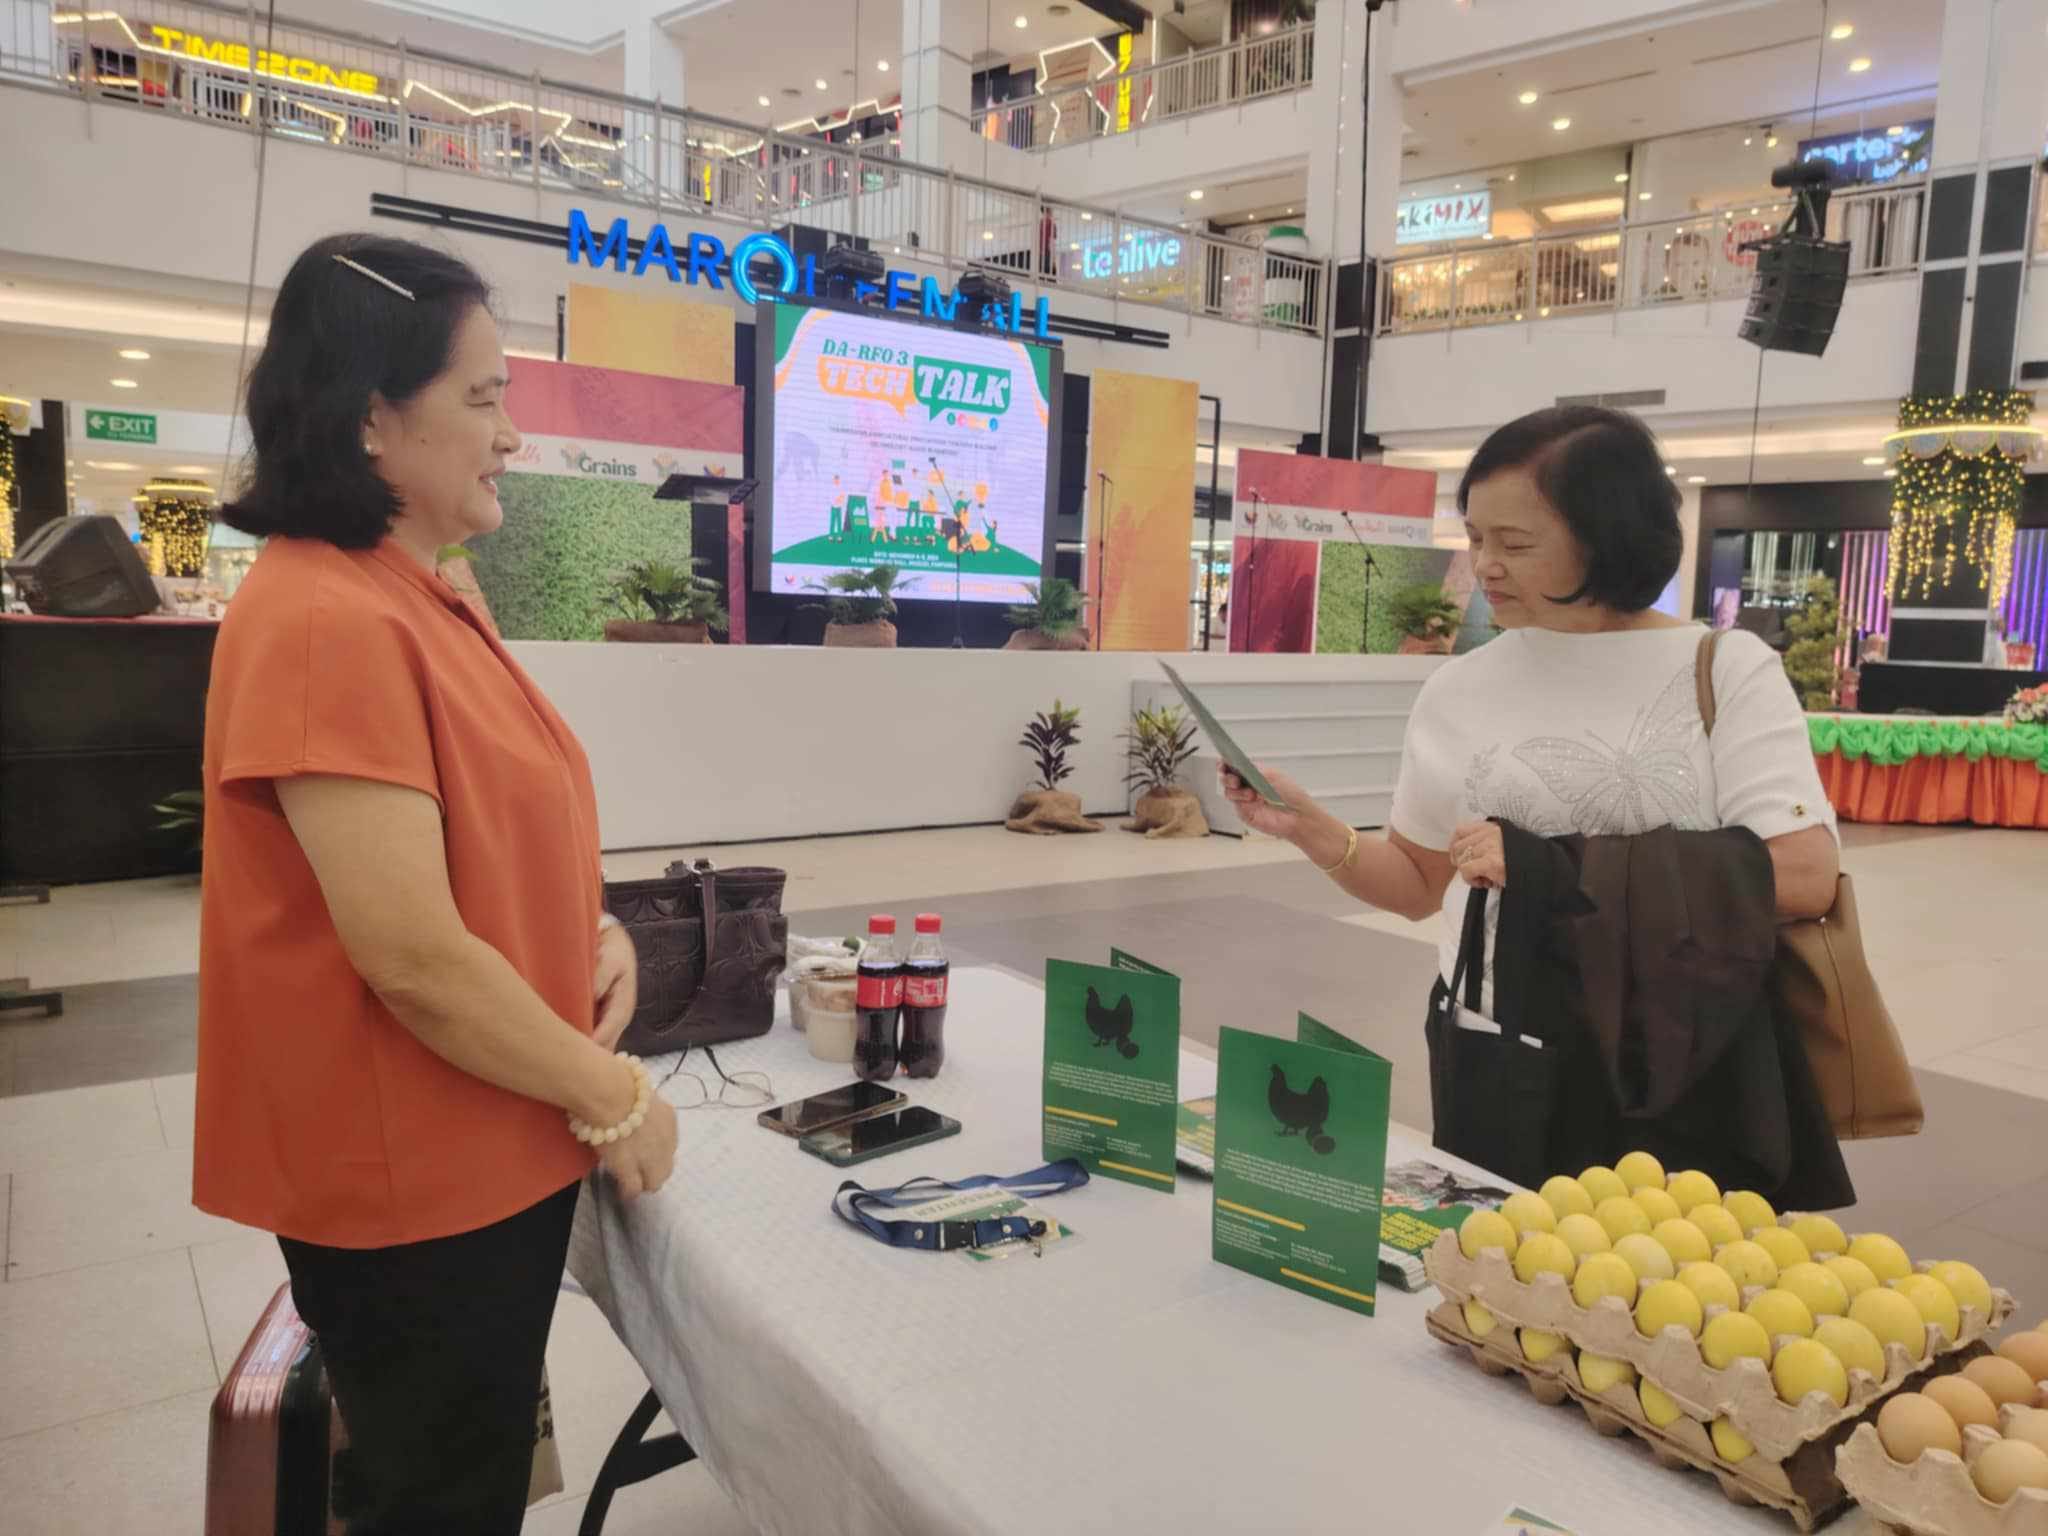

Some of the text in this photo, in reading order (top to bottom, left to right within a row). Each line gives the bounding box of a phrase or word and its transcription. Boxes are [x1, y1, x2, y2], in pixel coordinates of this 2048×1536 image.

[152, 25, 378, 96] TIMEZONE
[824, 362, 1010, 408] TECH TALK
[109, 416, 153, 434] EXIT
[578, 455, 638, 477] Grains
